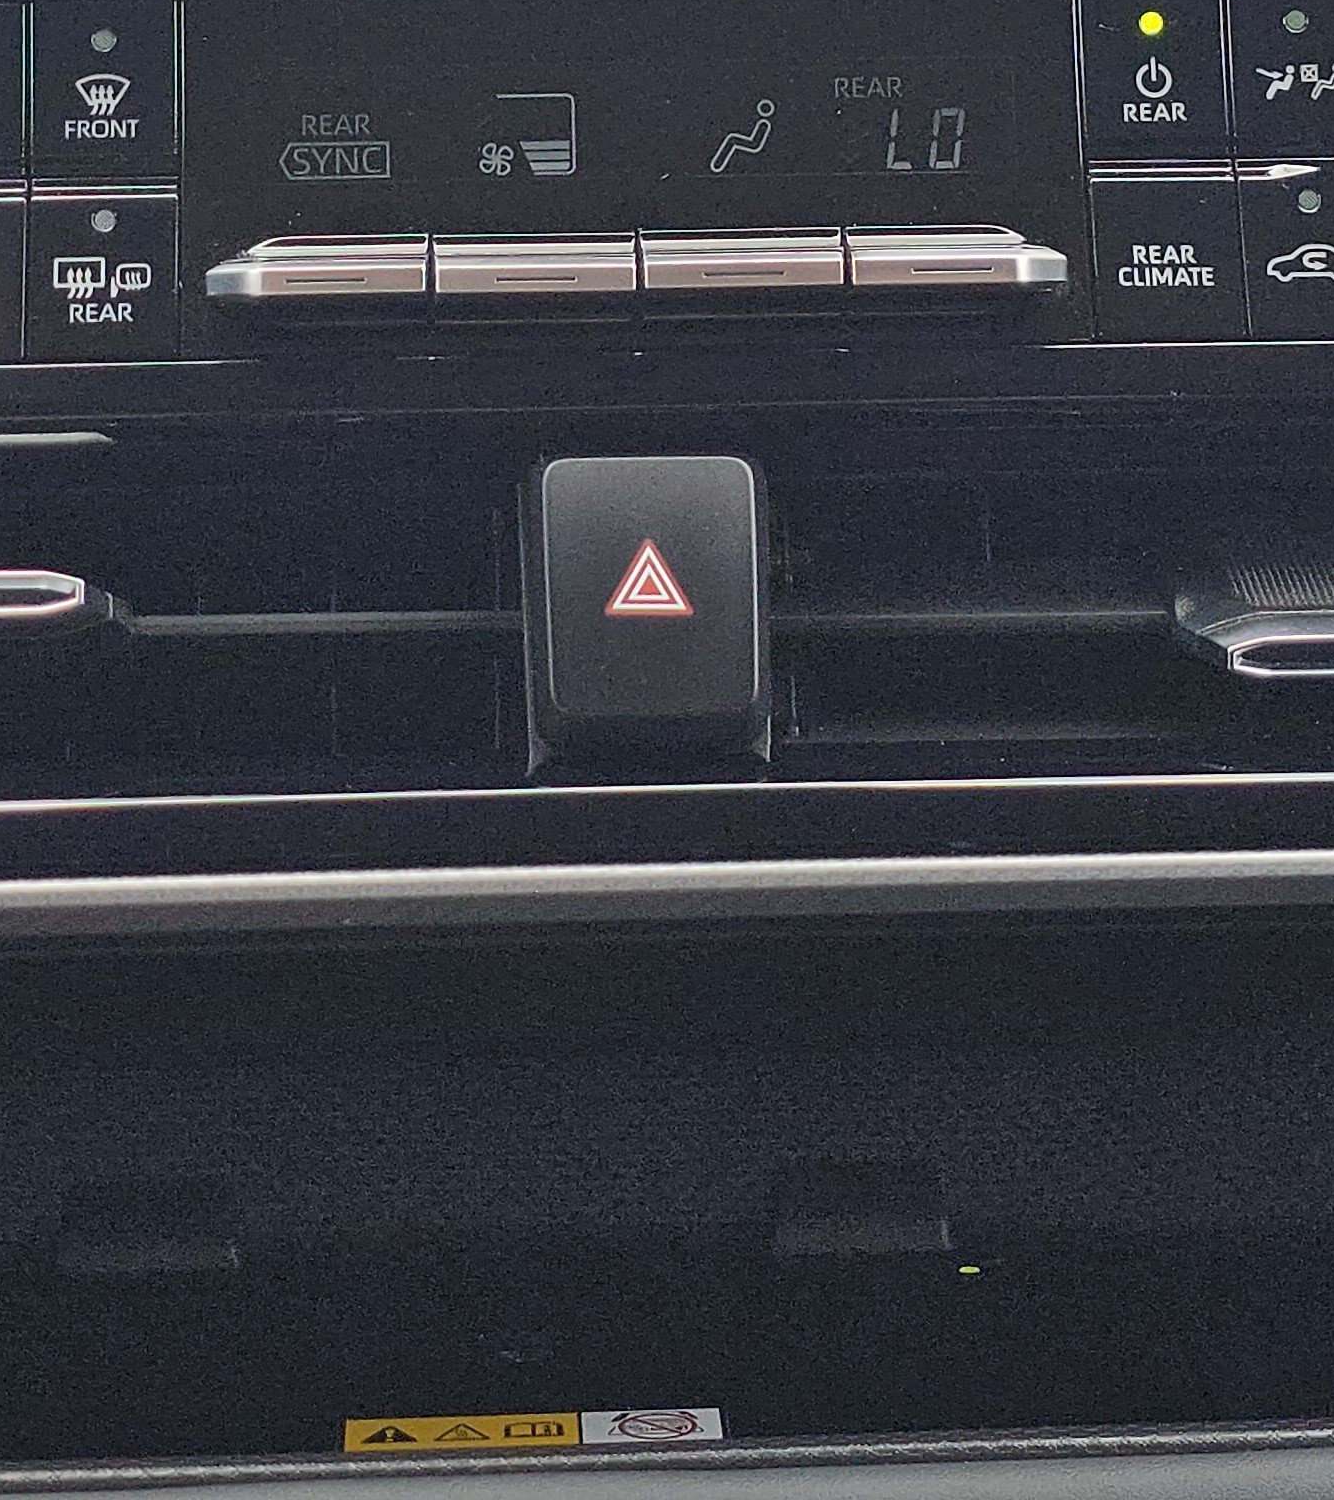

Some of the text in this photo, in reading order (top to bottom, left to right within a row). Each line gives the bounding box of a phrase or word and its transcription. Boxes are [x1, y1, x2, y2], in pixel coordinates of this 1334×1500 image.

[834, 77, 902, 99] REAR
[1123, 102, 1187, 122] REAR
[65, 119, 139, 139] FRONT
[301, 114, 370, 136] REAR
[294, 145, 381, 174] SYNC
[1133, 244, 1197, 264] REAR
[1118, 266, 1215, 287] CLIMATE
[69, 302, 133, 323] REAR
